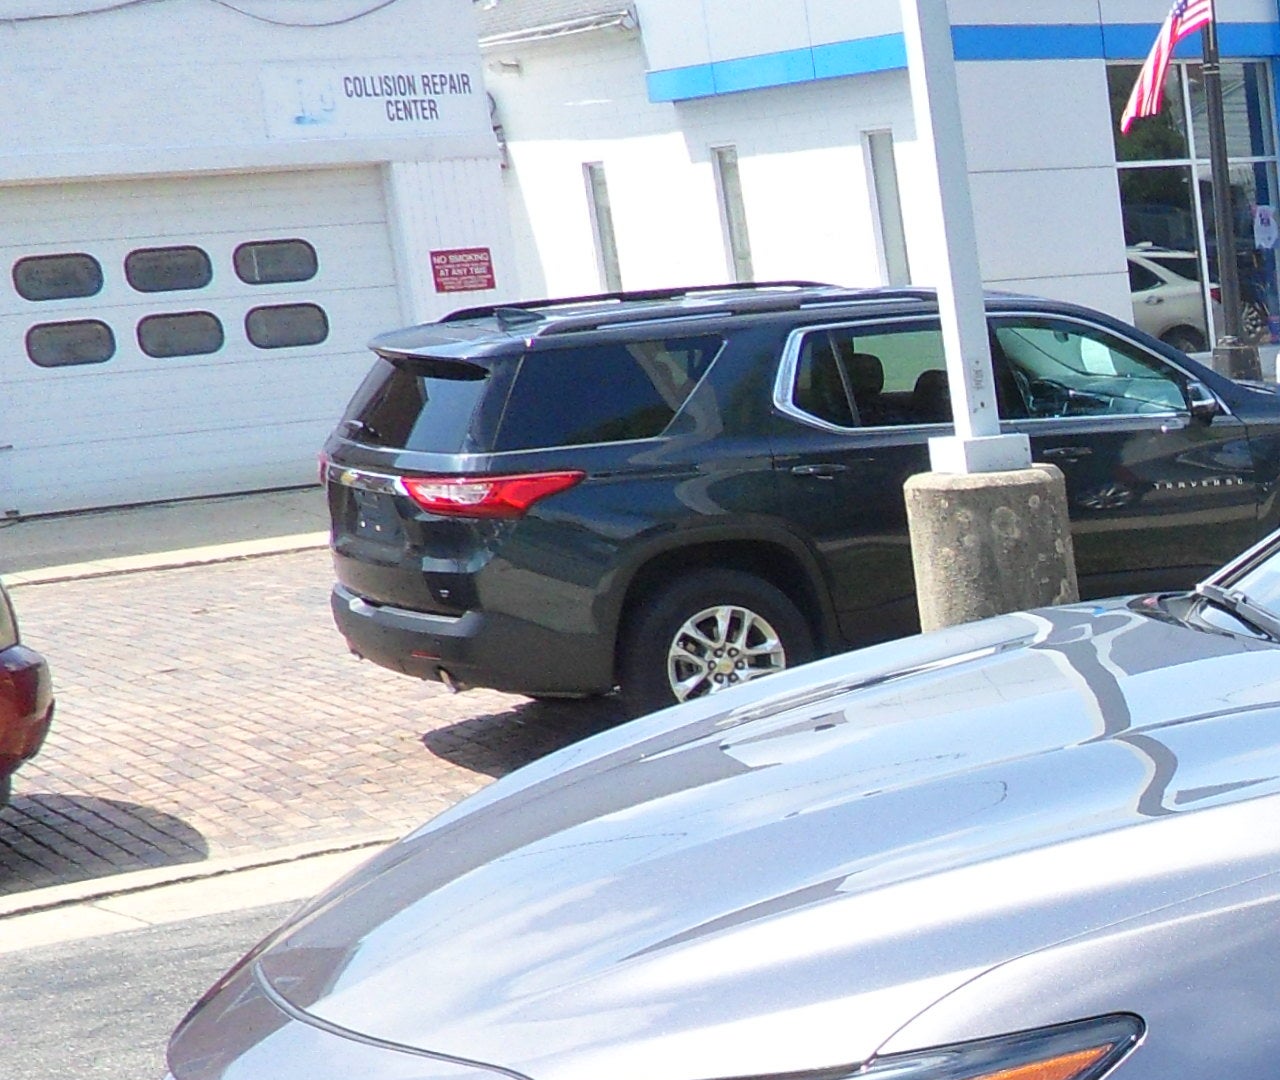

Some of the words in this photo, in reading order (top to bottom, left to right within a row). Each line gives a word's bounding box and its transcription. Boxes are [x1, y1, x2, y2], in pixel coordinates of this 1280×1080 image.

[343, 75, 416, 98] COLLISION
[422, 73, 472, 95] REPAIR
[385, 99, 440, 122] CENTER
[432, 255, 447, 264] NO
[448, 252, 489, 263] SMOKING
